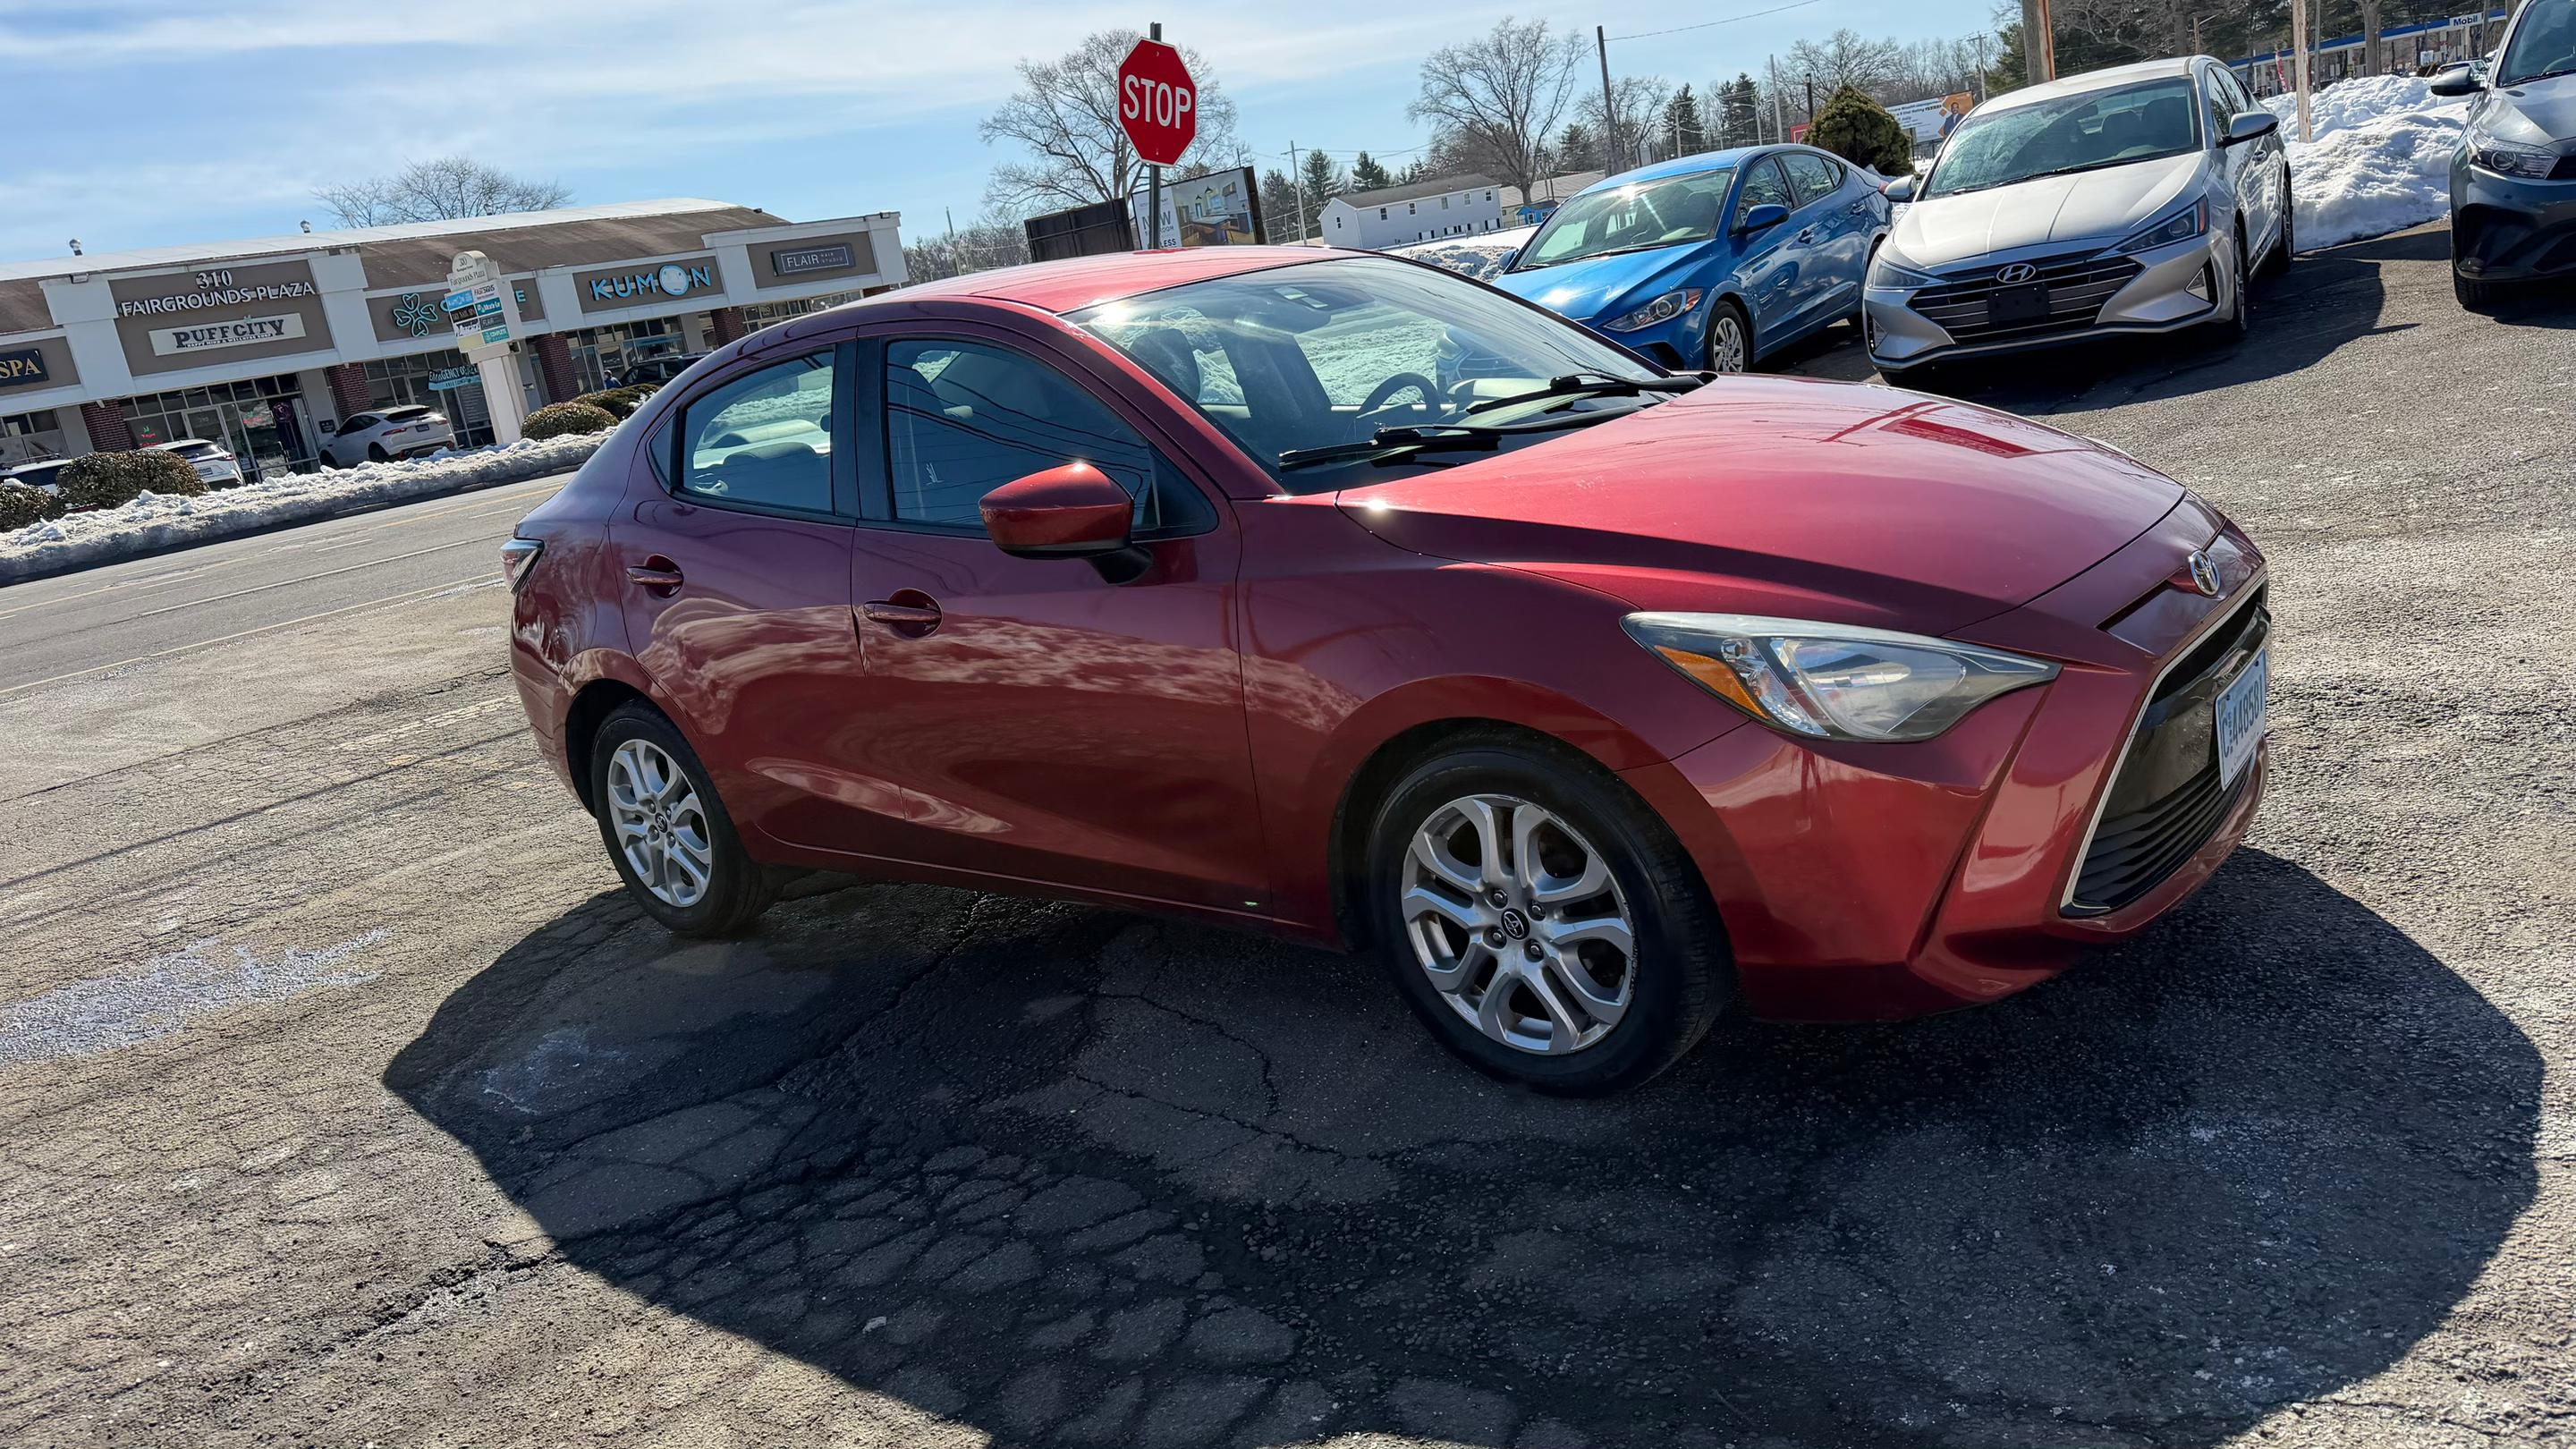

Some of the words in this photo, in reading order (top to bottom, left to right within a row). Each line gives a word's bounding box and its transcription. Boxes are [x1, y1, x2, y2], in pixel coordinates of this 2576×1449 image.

[2453, 15, 2478, 26] Mobil
[1123, 74, 1191, 129] STOP
[1142, 210, 1171, 230] NW
[786, 254, 820, 267] FLAIR
[195, 269, 233, 289] 310
[590, 265, 712, 301] KUMON
[121, 288, 251, 317] FAIRGROUNDS
[257, 281, 316, 301] PLAZA
[0, 357, 42, 379] SPA
